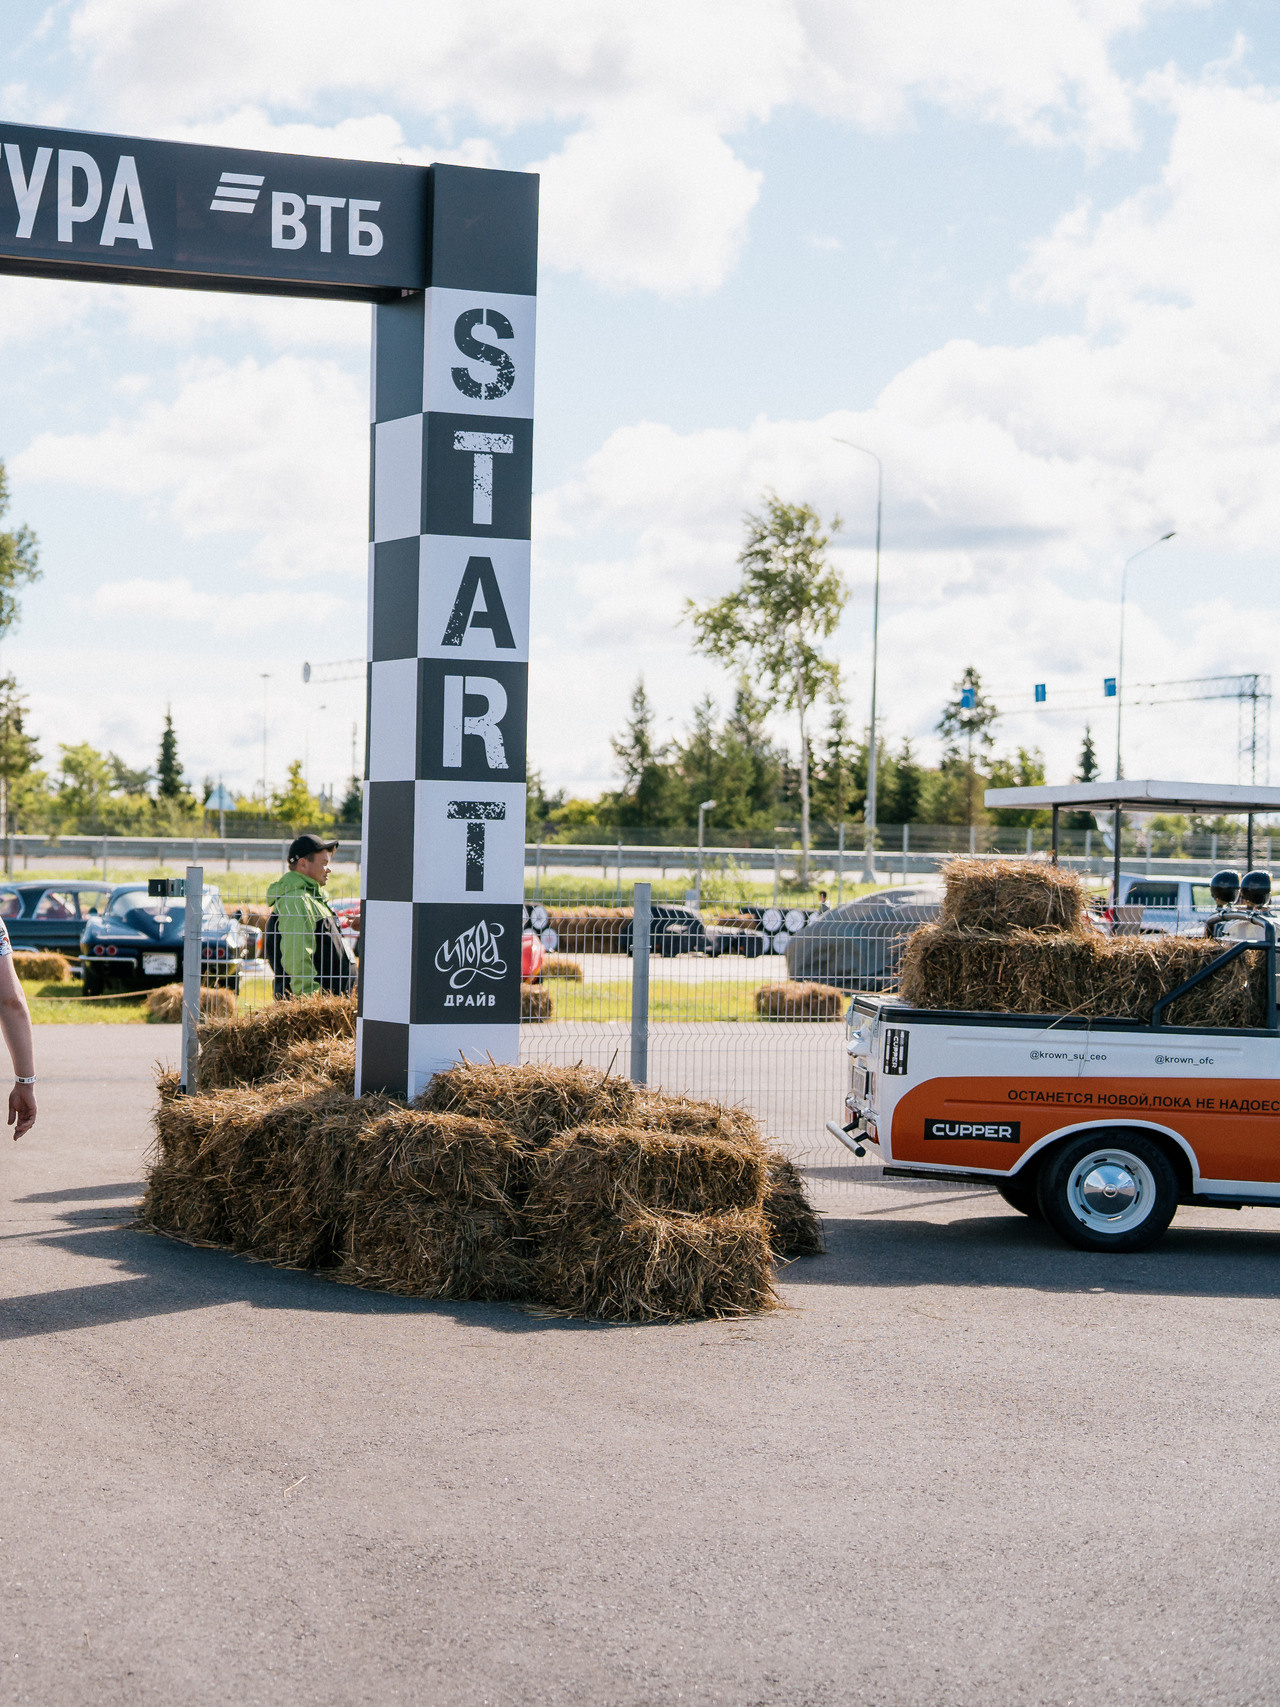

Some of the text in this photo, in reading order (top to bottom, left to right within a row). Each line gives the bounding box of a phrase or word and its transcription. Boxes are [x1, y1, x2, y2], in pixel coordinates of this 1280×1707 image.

[270, 191, 385, 257] ВТБ
[440, 308, 517, 892] START
[443, 992, 496, 1007] ДРАЙВ
[1029, 1050, 1107, 1062] @krown_su_ceo
[1154, 1054, 1214, 1066] @krown_ofc
[1007, 1089, 1093, 1104] ОСТАНЕТСЯ
[1196, 1098, 1214, 1109] НЕ
[932, 1123, 1012, 1139] CUPPER
